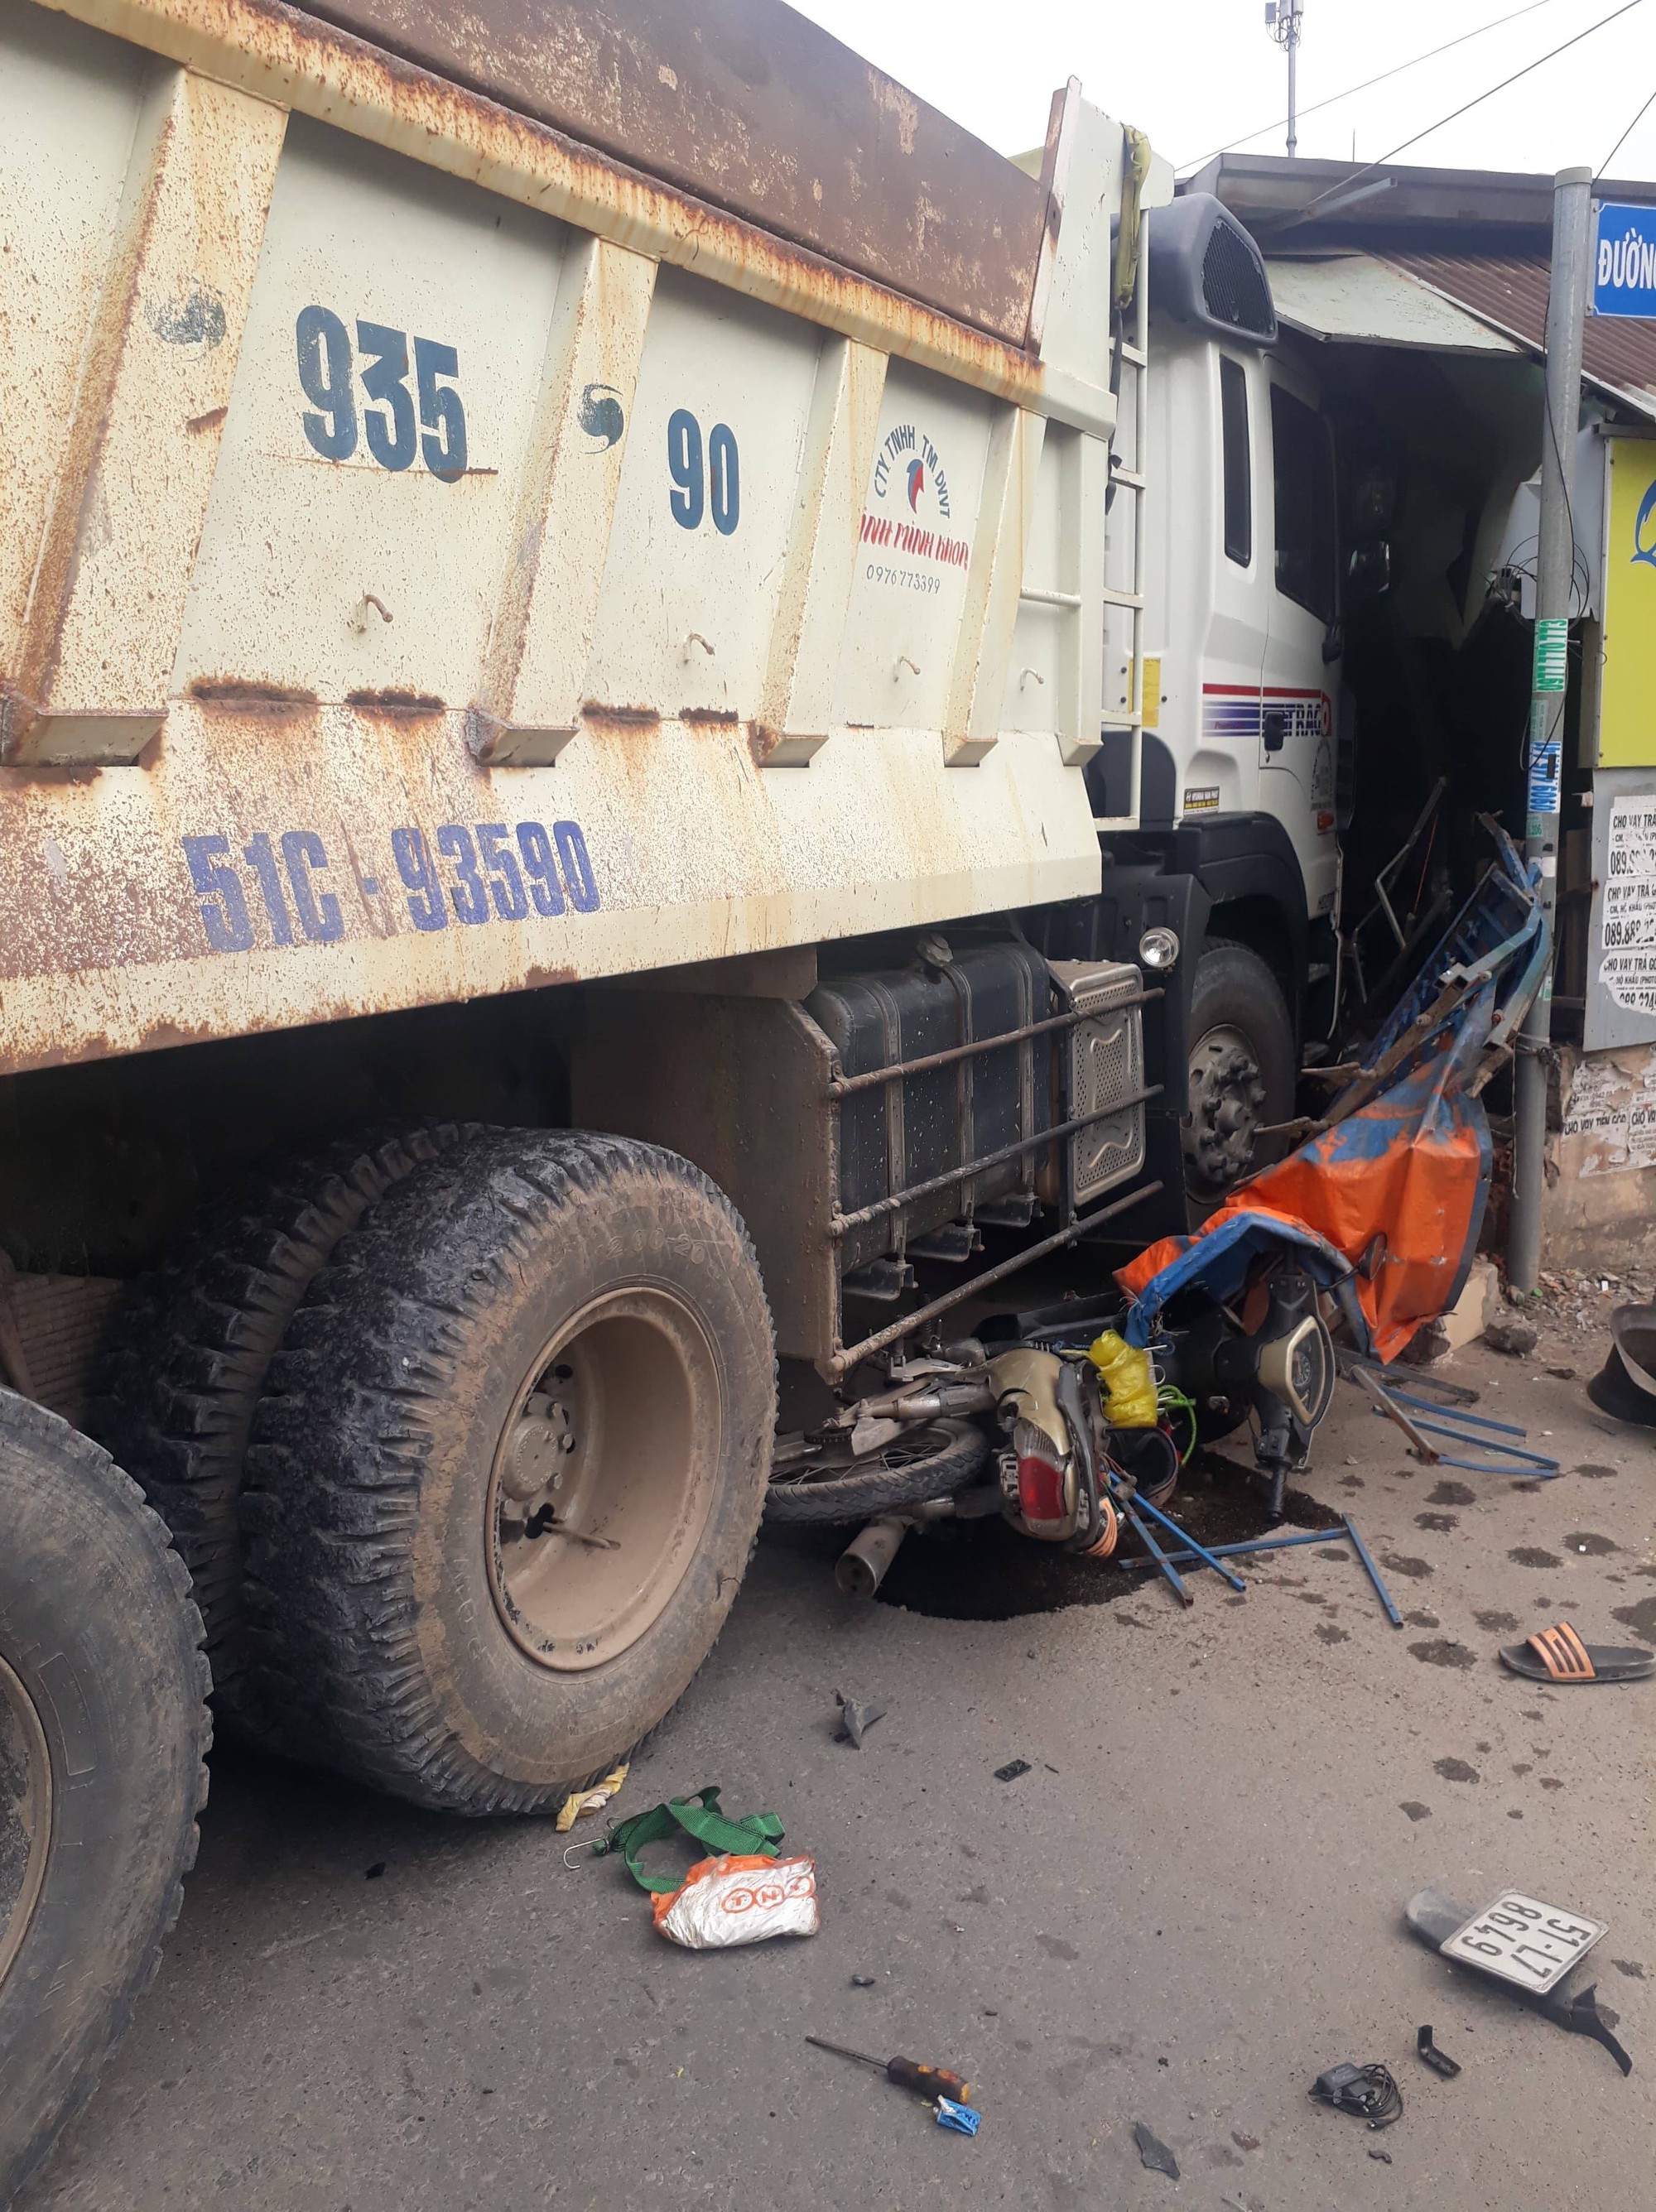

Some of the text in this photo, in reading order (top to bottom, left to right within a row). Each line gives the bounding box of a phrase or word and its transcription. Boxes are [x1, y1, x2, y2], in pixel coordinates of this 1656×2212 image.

[1598, 228, 1656, 290] ĐƯỜN
[296, 305, 468, 483] 935
[668, 408, 739, 536] 90
[867, 565, 941, 594] 0976773399
[1461, 1901, 1543, 1957] 8649
